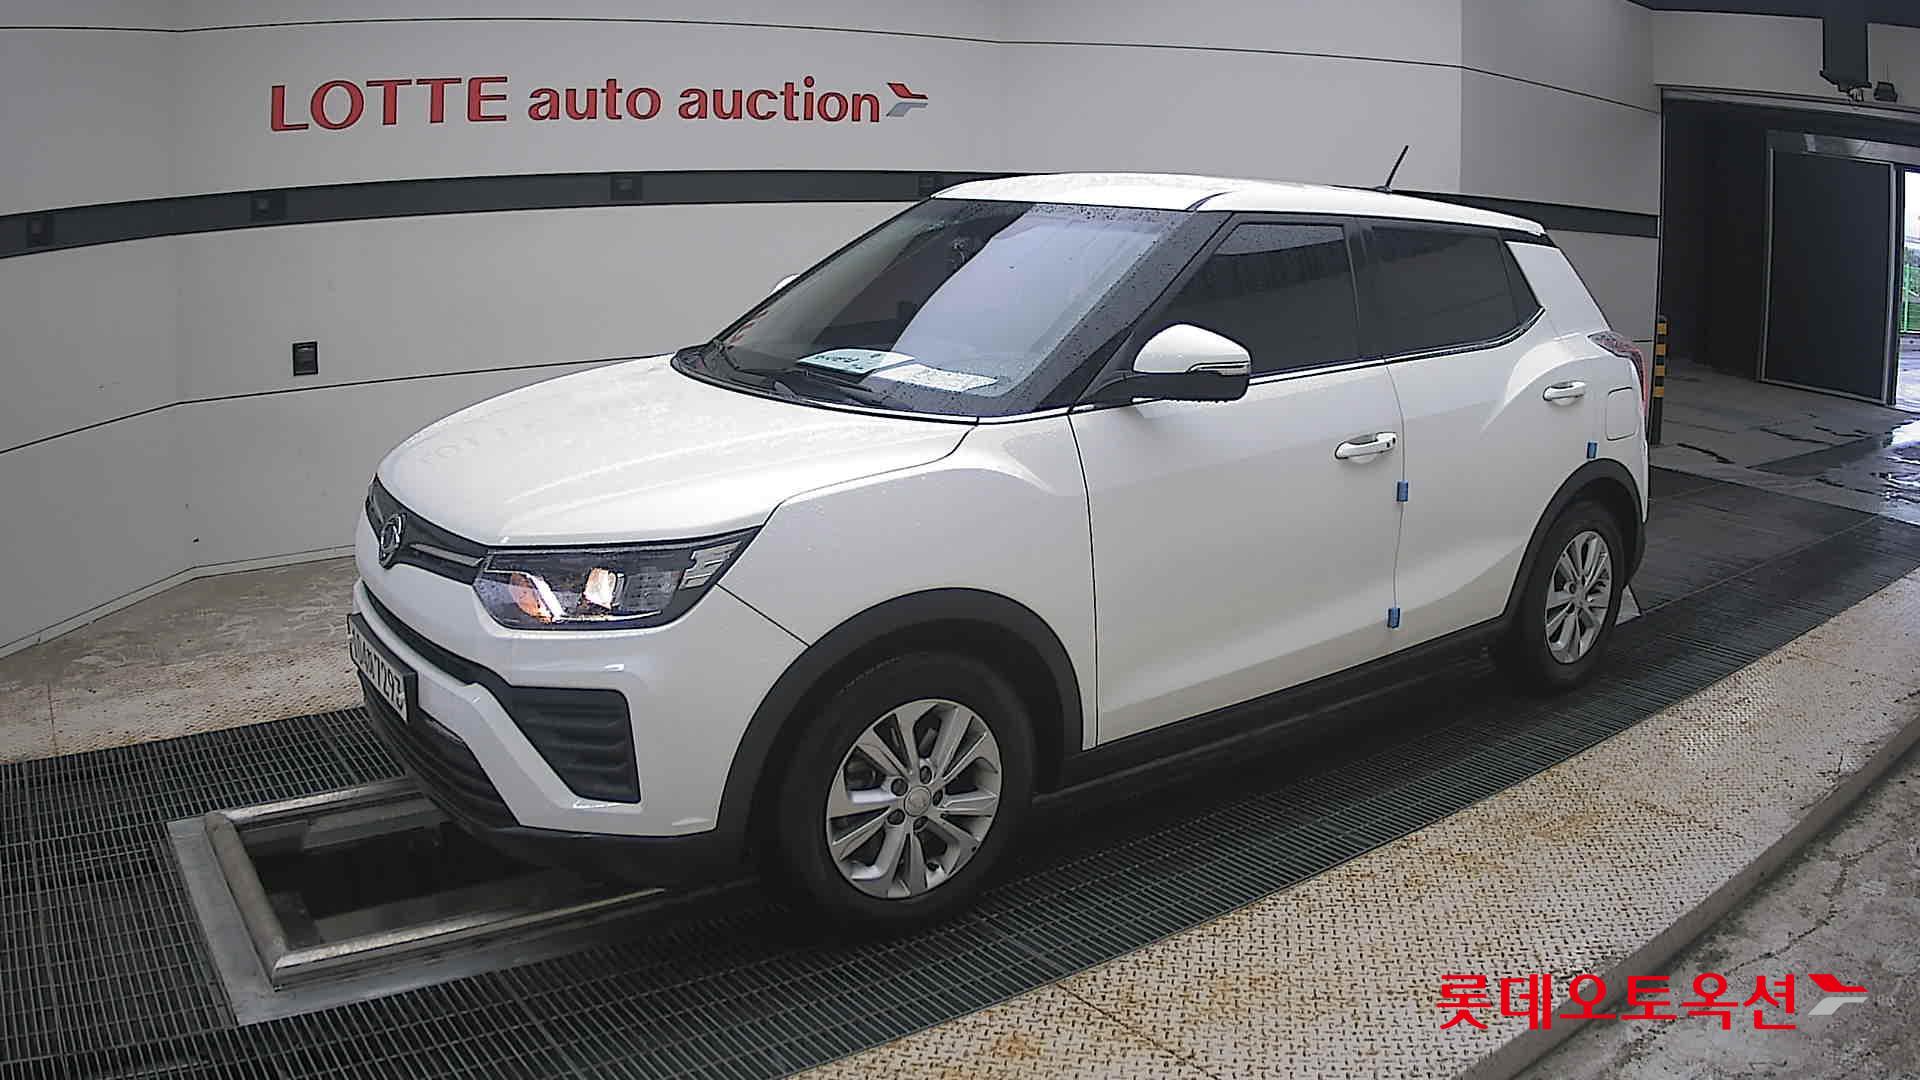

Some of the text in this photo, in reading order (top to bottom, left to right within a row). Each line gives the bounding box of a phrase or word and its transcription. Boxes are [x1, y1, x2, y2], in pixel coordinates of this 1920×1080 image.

[270, 76, 881, 132] LOTTE auto auction
